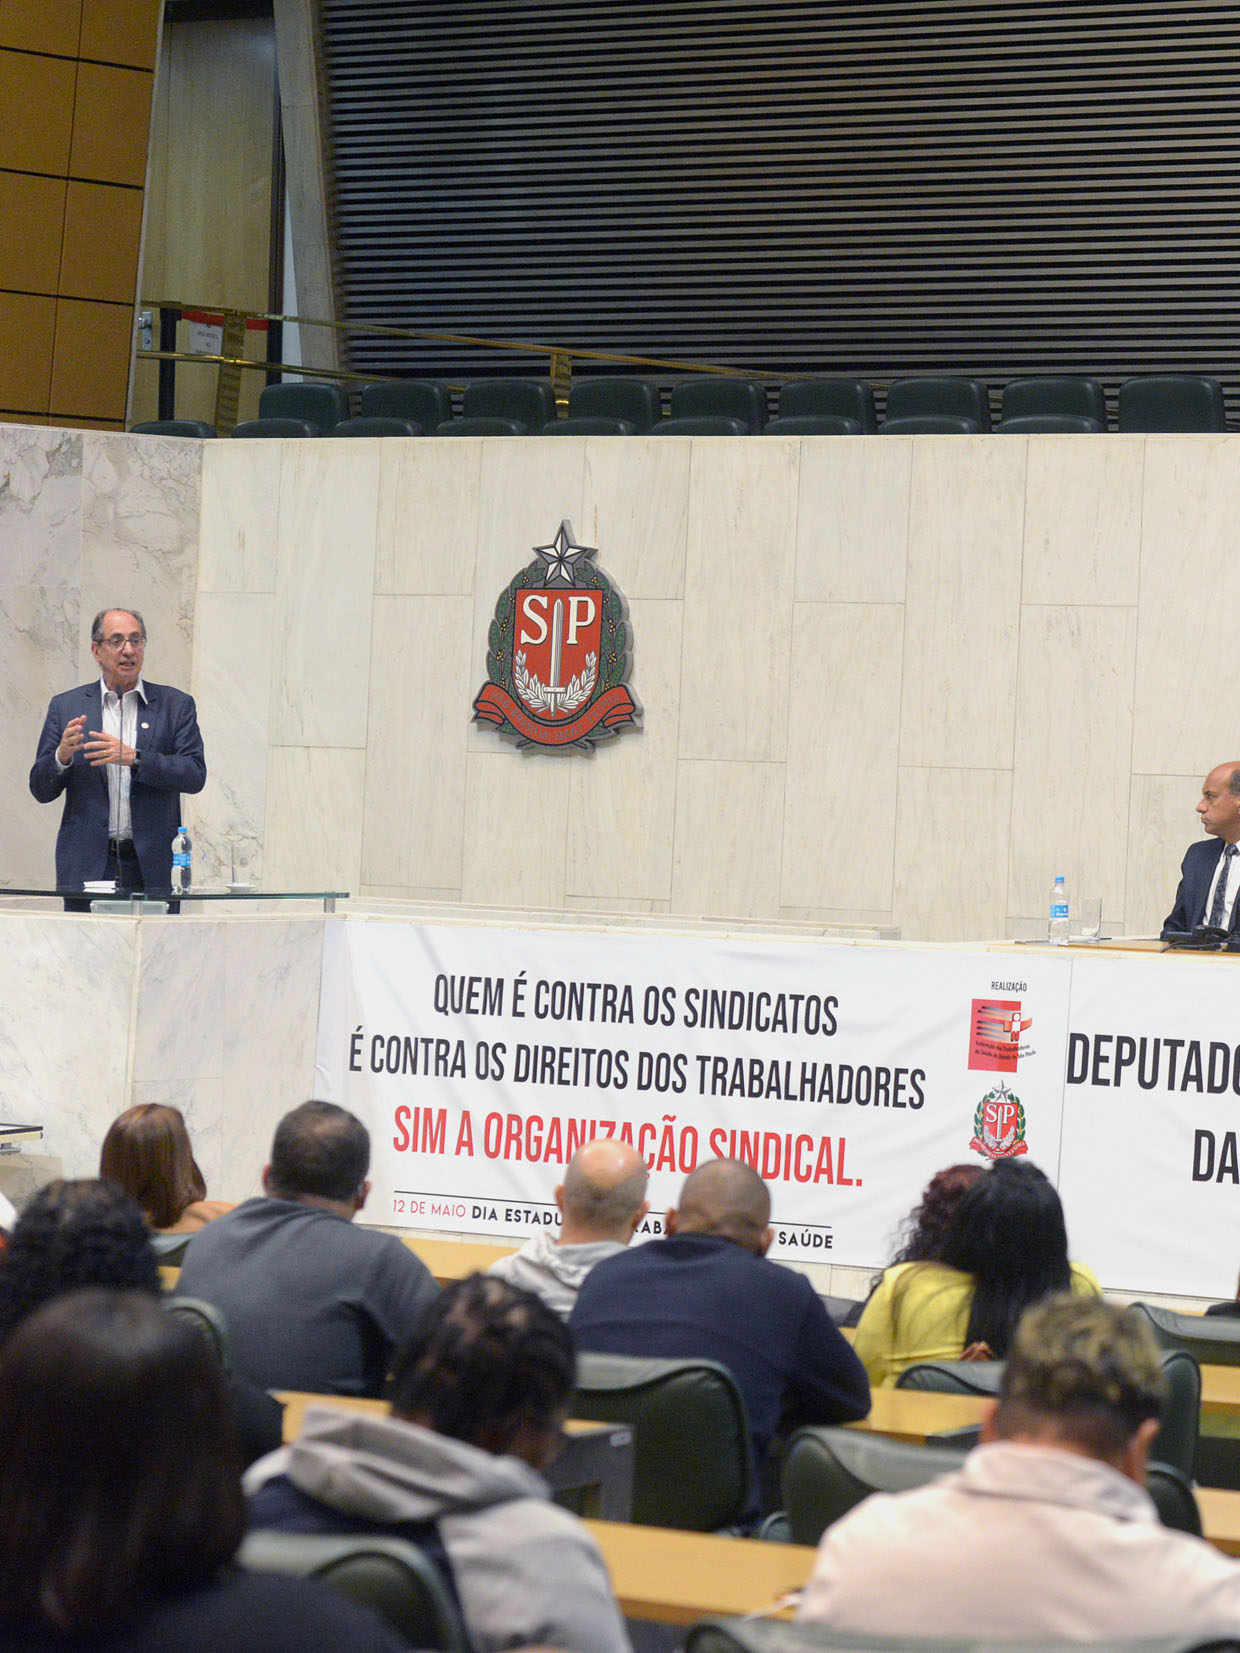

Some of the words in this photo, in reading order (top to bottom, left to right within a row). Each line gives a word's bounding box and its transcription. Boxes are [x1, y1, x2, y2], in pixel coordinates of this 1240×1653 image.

[434, 974, 504, 1016] QUEM
[512, 970, 528, 1018] É
[535, 980, 633, 1025] CONTRA
[643, 986, 677, 1026] OS
[684, 989, 838, 1036] SINDICATOS
[991, 980, 1028, 993] REALIZAÇÃO
[349, 1025, 364, 1073] É
[371, 1035, 466, 1079] CONTRA
[475, 1042, 507, 1082] OS
[514, 1044, 628, 1090] DIREITOS
[638, 1052, 688, 1094] DOS
[696, 1056, 926, 1110] TRABALHADORES
[393, 1106, 448, 1155] SIM
[456, 1111, 474, 1157] A
[709, 1128, 863, 1187] SINDICAL.
[1192, 1129, 1240, 1185] DA
[393, 1200, 405, 1213] 12
[410, 1200, 426, 1215] DE
[431, 1203, 466, 1218] MAIO
[472, 1206, 498, 1221] DIA
[505, 1208, 563, 1227] ESTADU
[778, 1229, 833, 1249] SAÚDE
